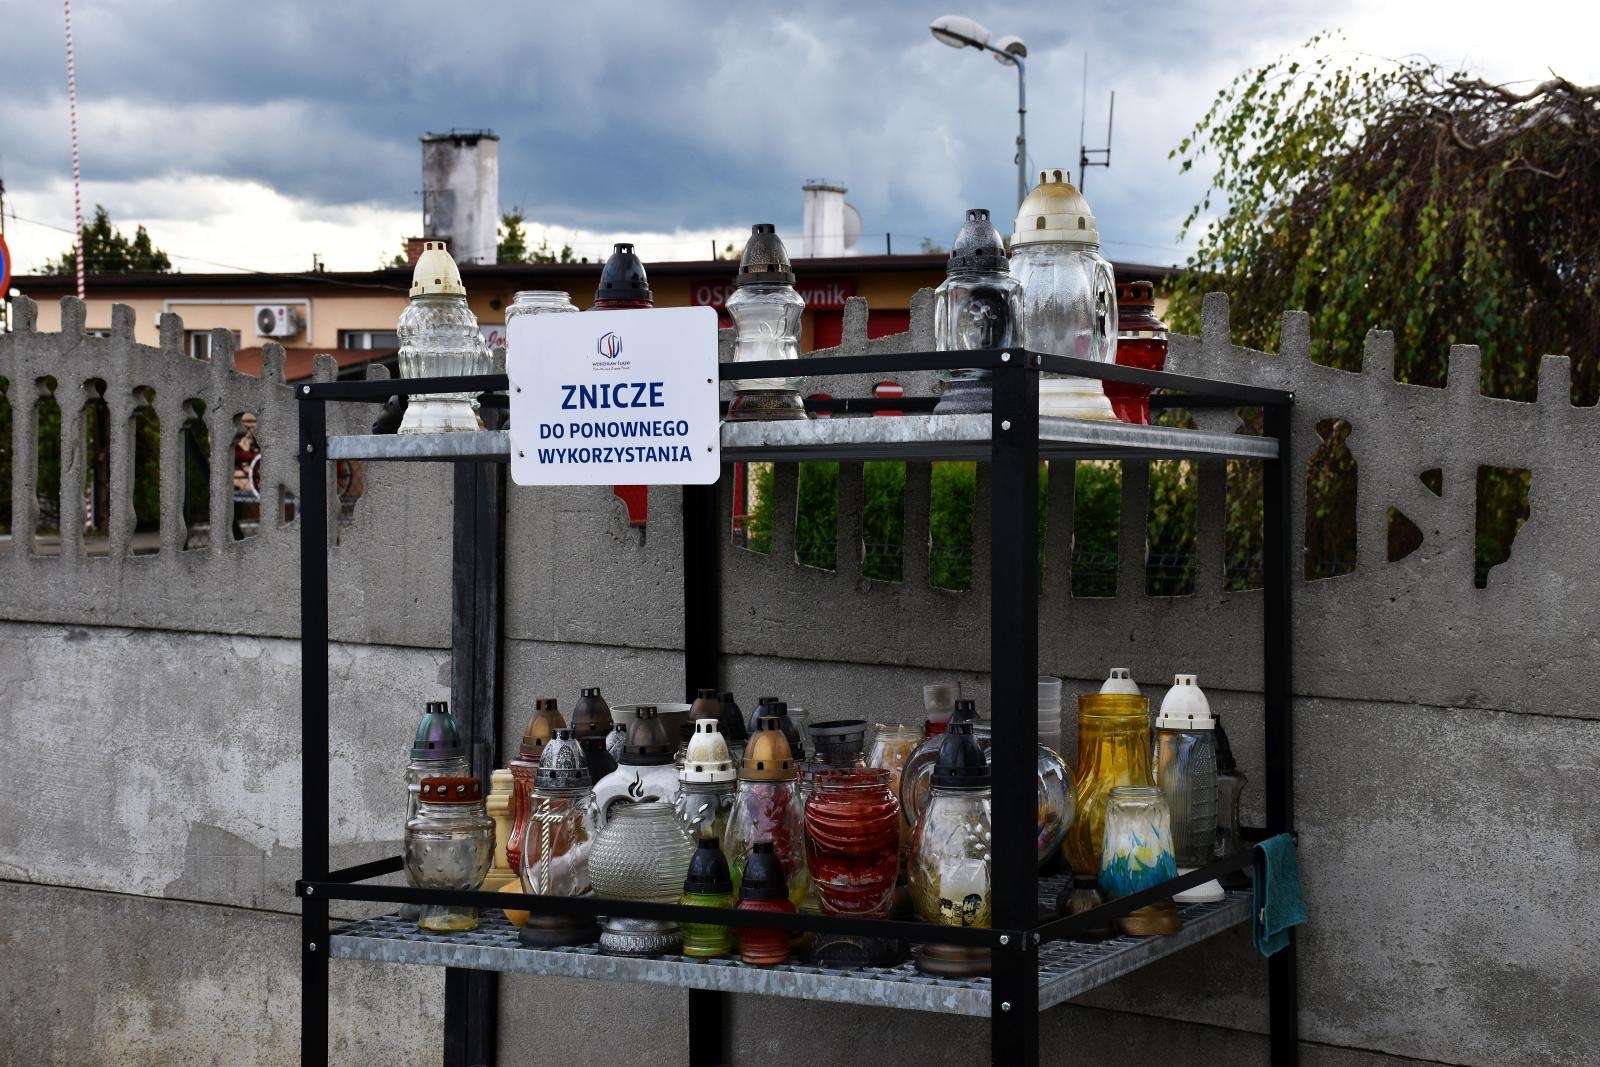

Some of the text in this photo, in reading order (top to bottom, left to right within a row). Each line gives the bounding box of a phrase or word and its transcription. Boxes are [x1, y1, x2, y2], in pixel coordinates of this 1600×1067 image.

[801, 283, 846, 305] wnik
[561, 382, 665, 410] ZNICZE
[540, 420, 689, 439] DO PONOWNEGO
[538, 445, 692, 464] WYKORZYSTANIA
